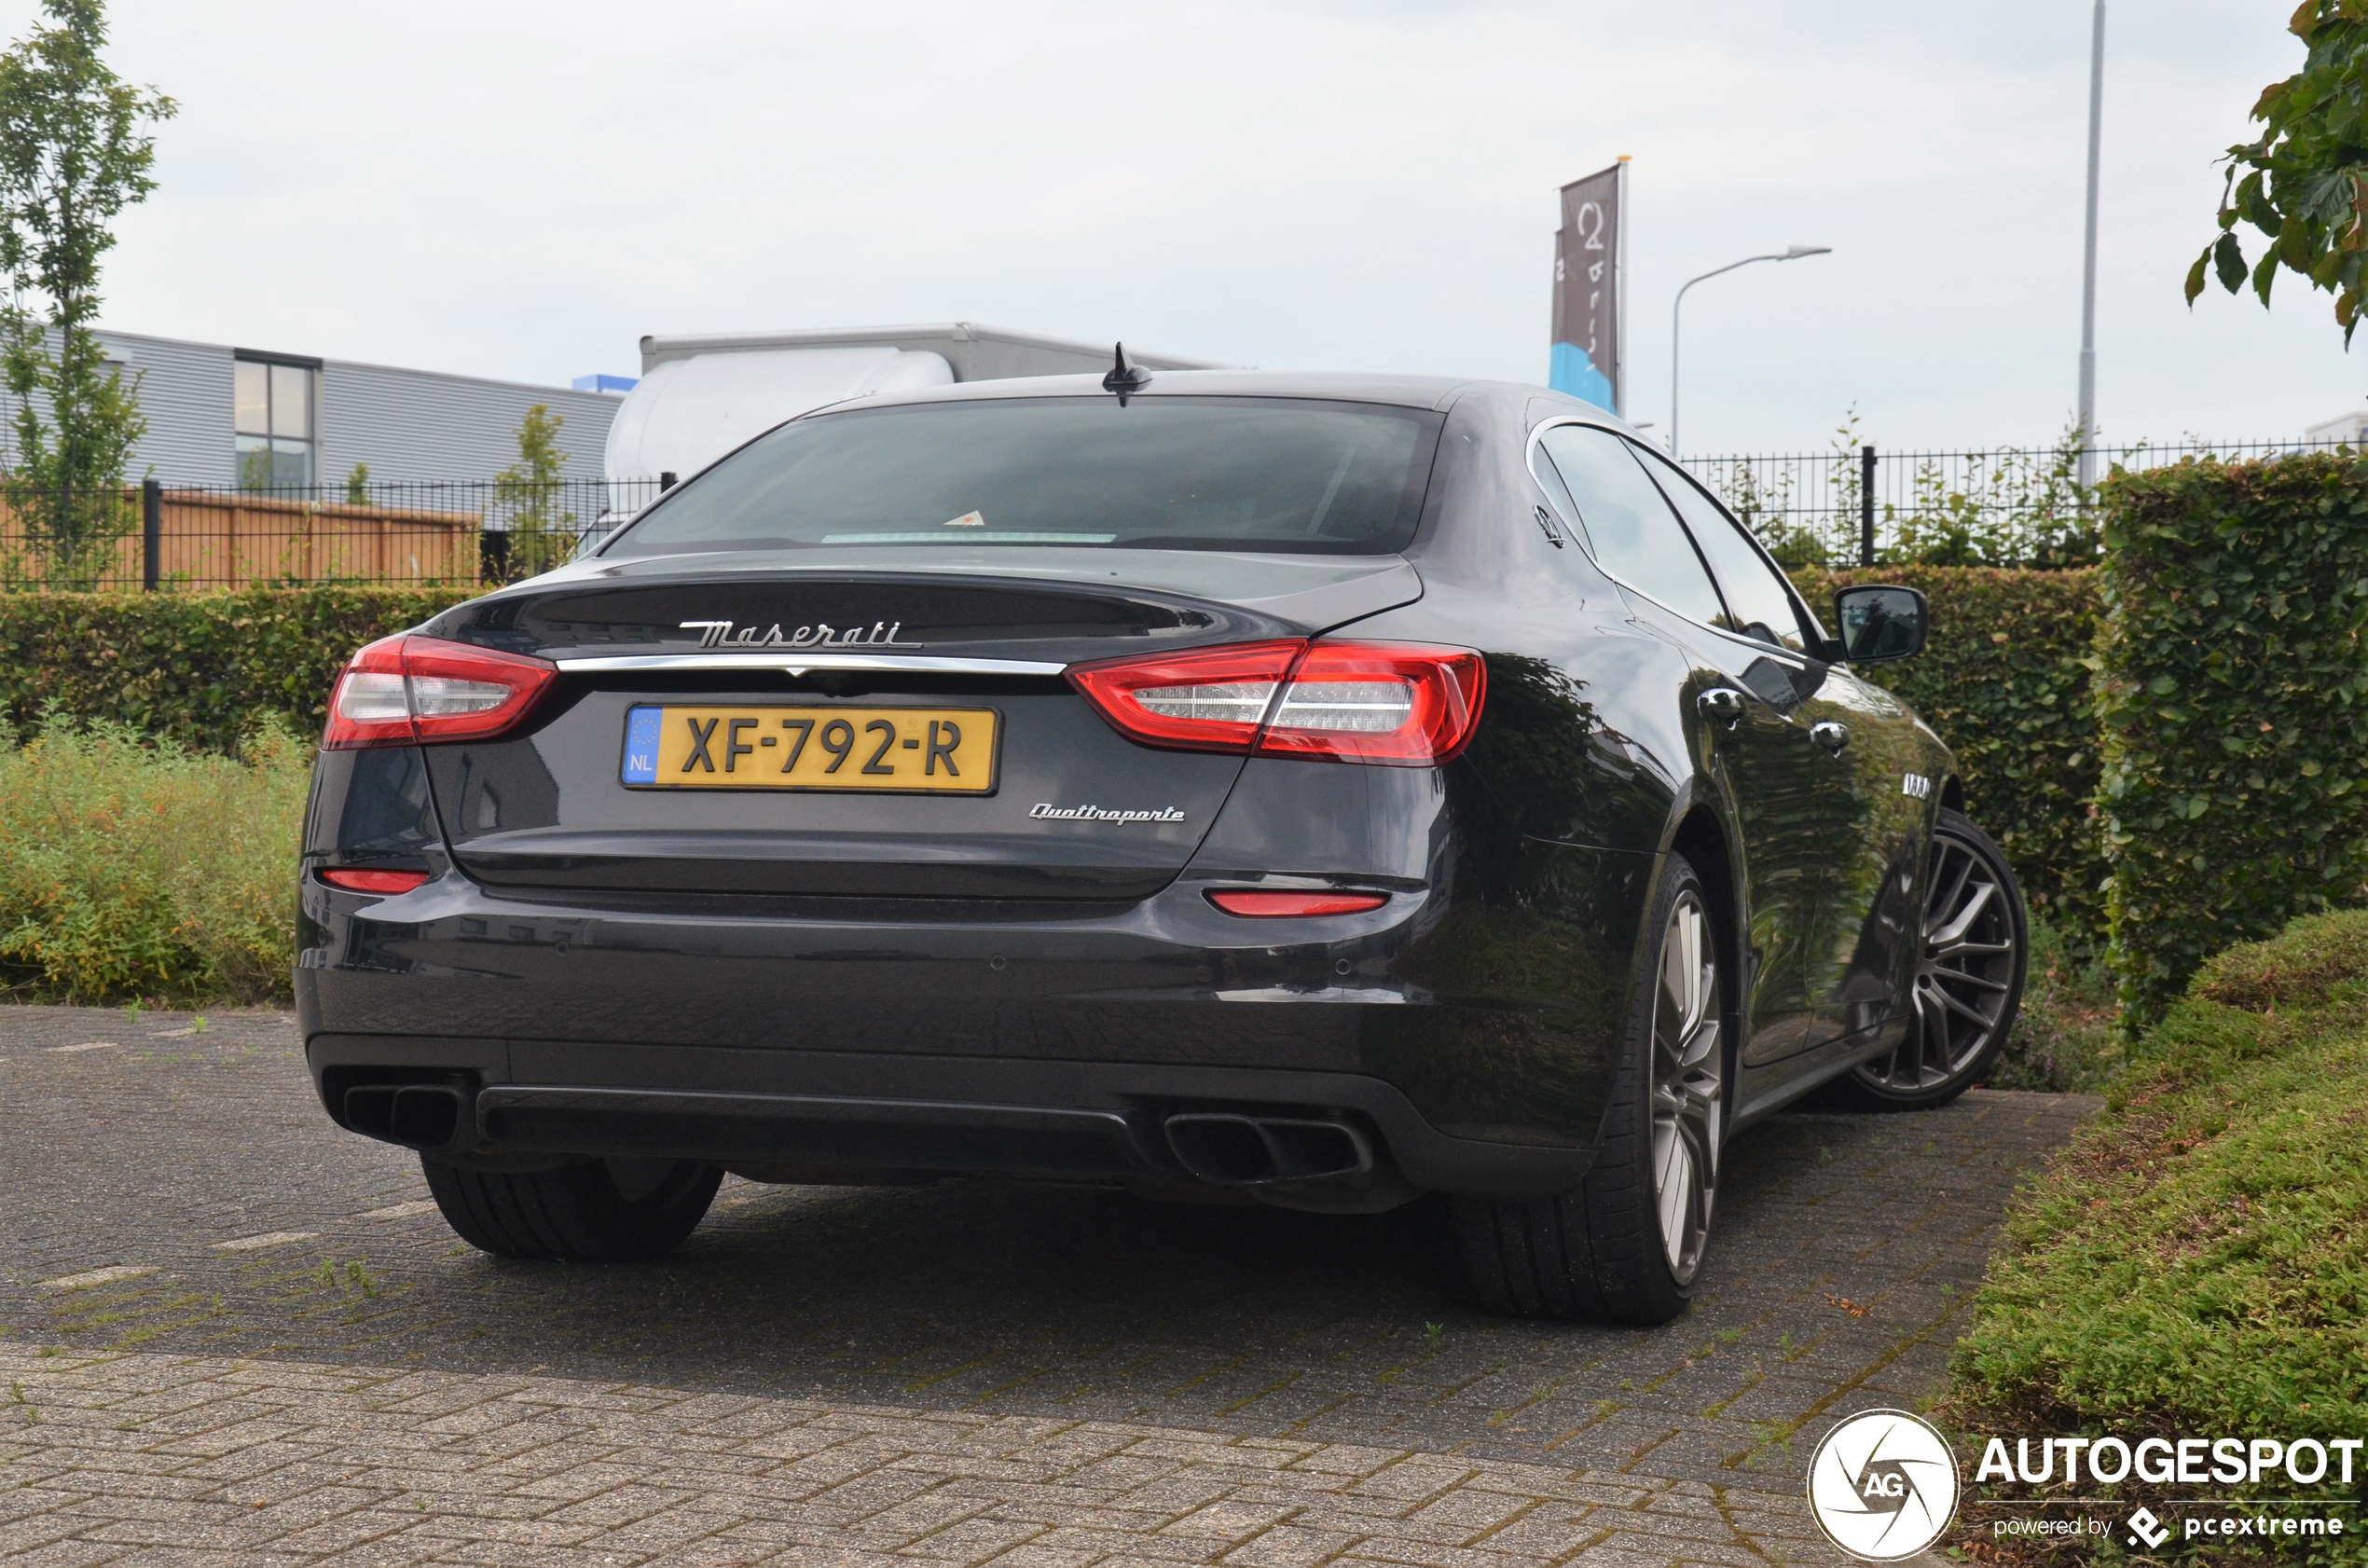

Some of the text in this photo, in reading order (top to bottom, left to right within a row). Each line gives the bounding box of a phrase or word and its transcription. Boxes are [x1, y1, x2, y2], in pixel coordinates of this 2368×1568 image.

[680, 621, 924, 649] Maserati
[681, 718, 961, 777] XF-792-R
[630, 754, 653, 772] NL
[1028, 803, 1186, 826] Quattroporte
